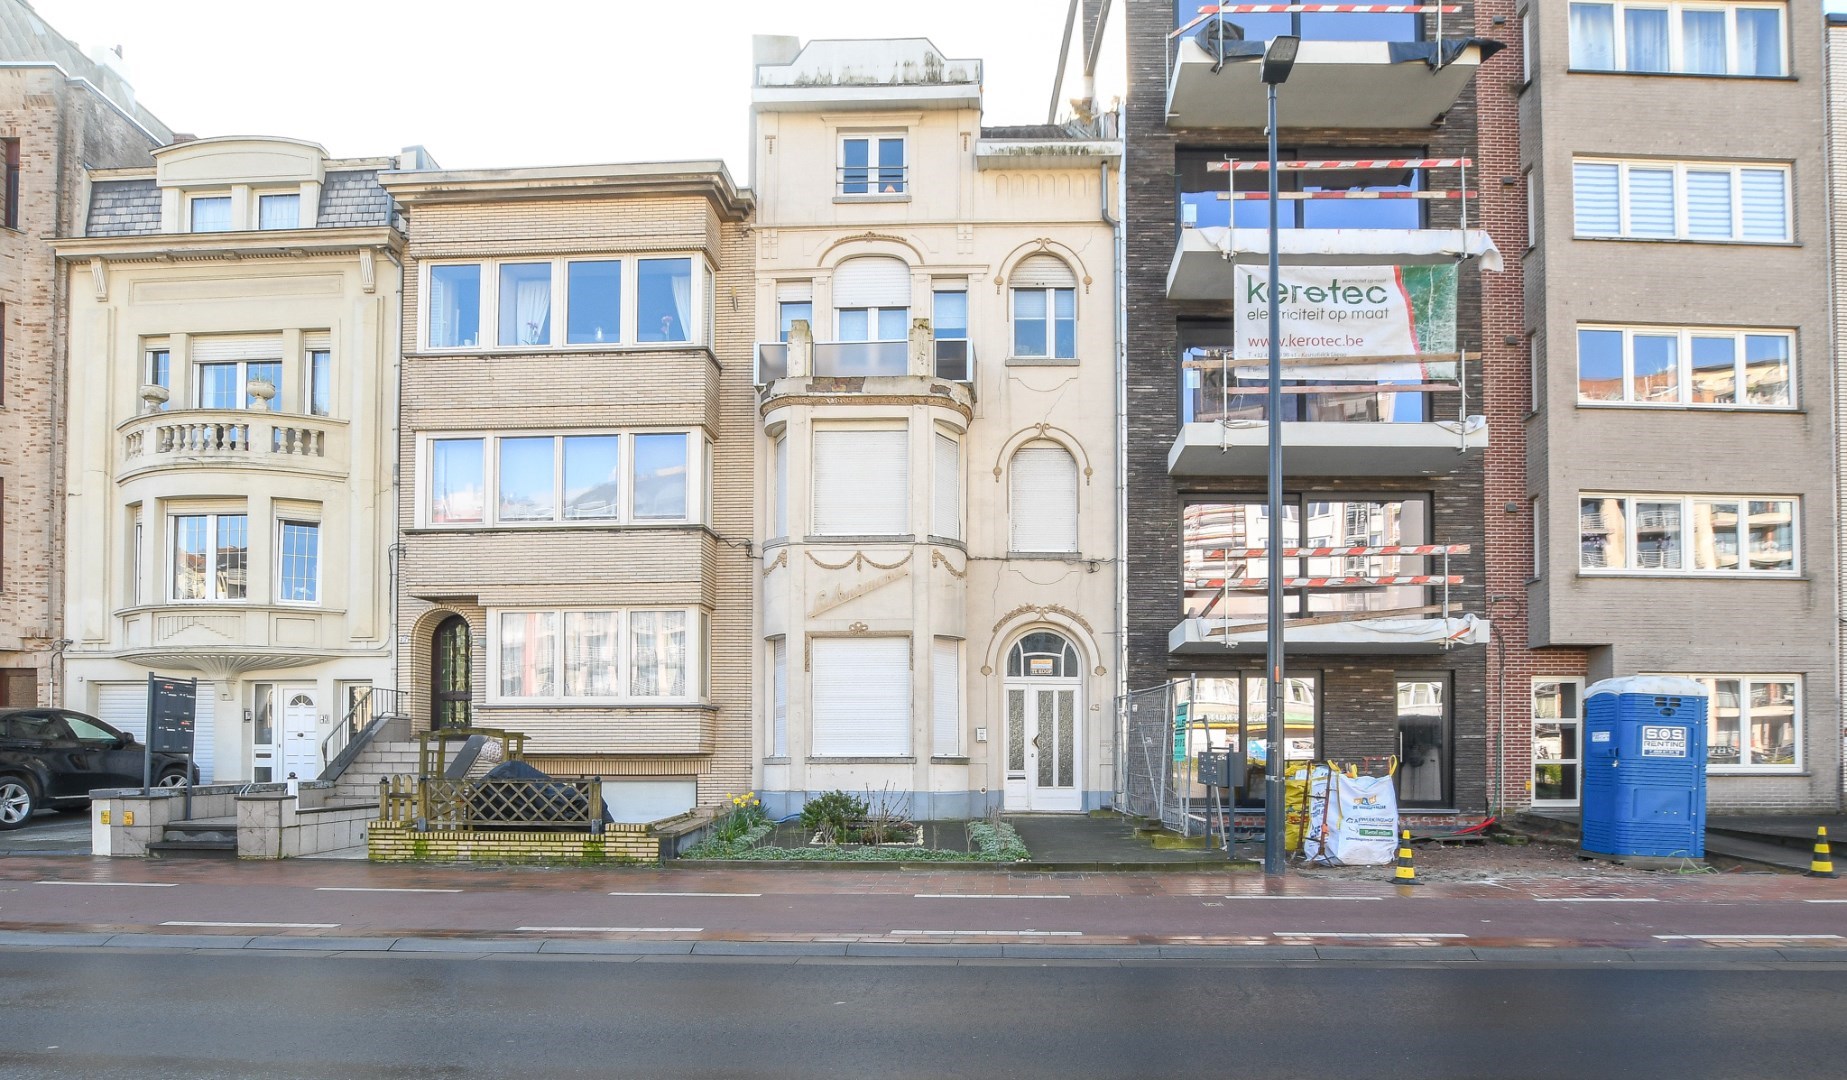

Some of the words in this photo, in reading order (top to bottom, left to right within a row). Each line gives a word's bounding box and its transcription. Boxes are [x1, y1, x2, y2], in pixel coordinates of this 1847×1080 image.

[1247, 308, 1325, 320] elericiteit
[1328, 309, 1346, 323] op
[1351, 307, 1390, 320] maat
[1090, 703, 1100, 712] 45
